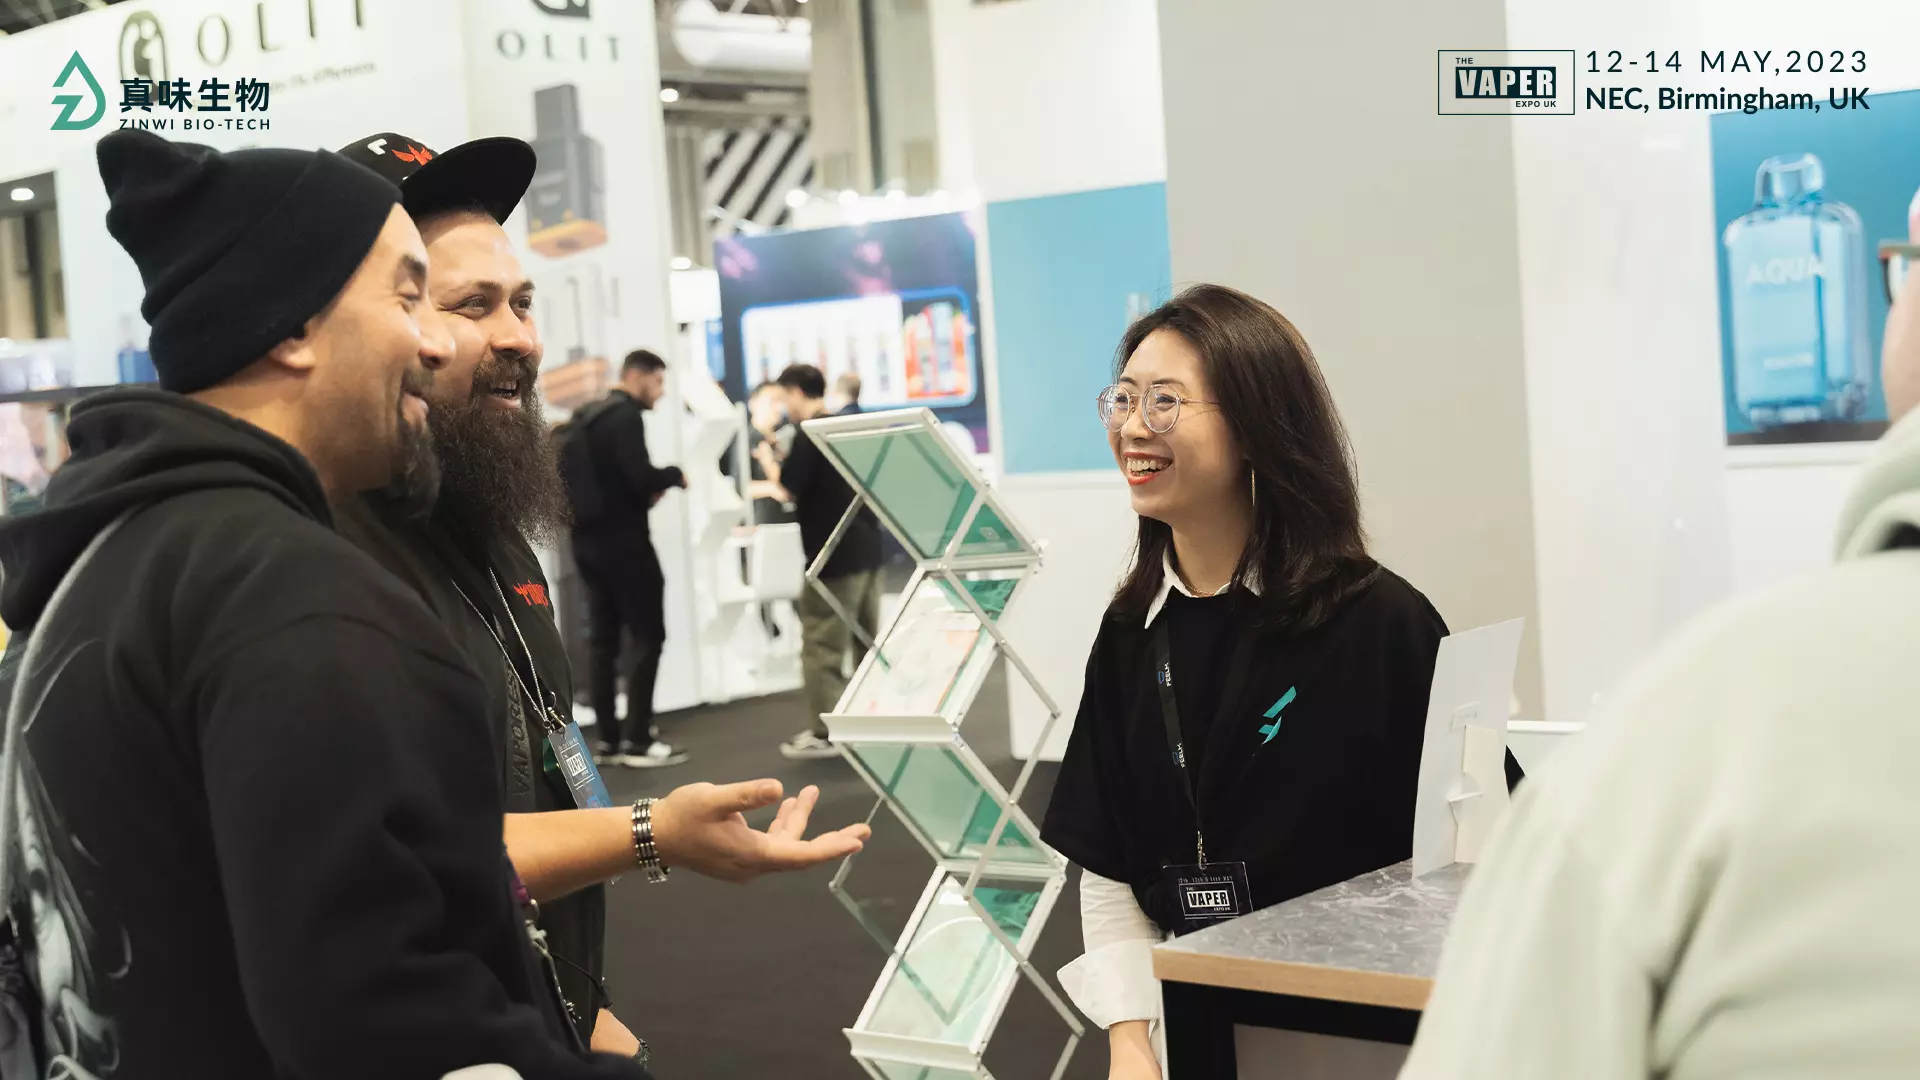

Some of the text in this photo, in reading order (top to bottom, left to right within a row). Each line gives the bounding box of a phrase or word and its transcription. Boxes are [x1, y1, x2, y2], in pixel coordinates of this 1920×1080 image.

[496, 29, 619, 62] OLIT
[1746, 254, 1826, 285] AQUA
[1189, 891, 1228, 906] VAPER
